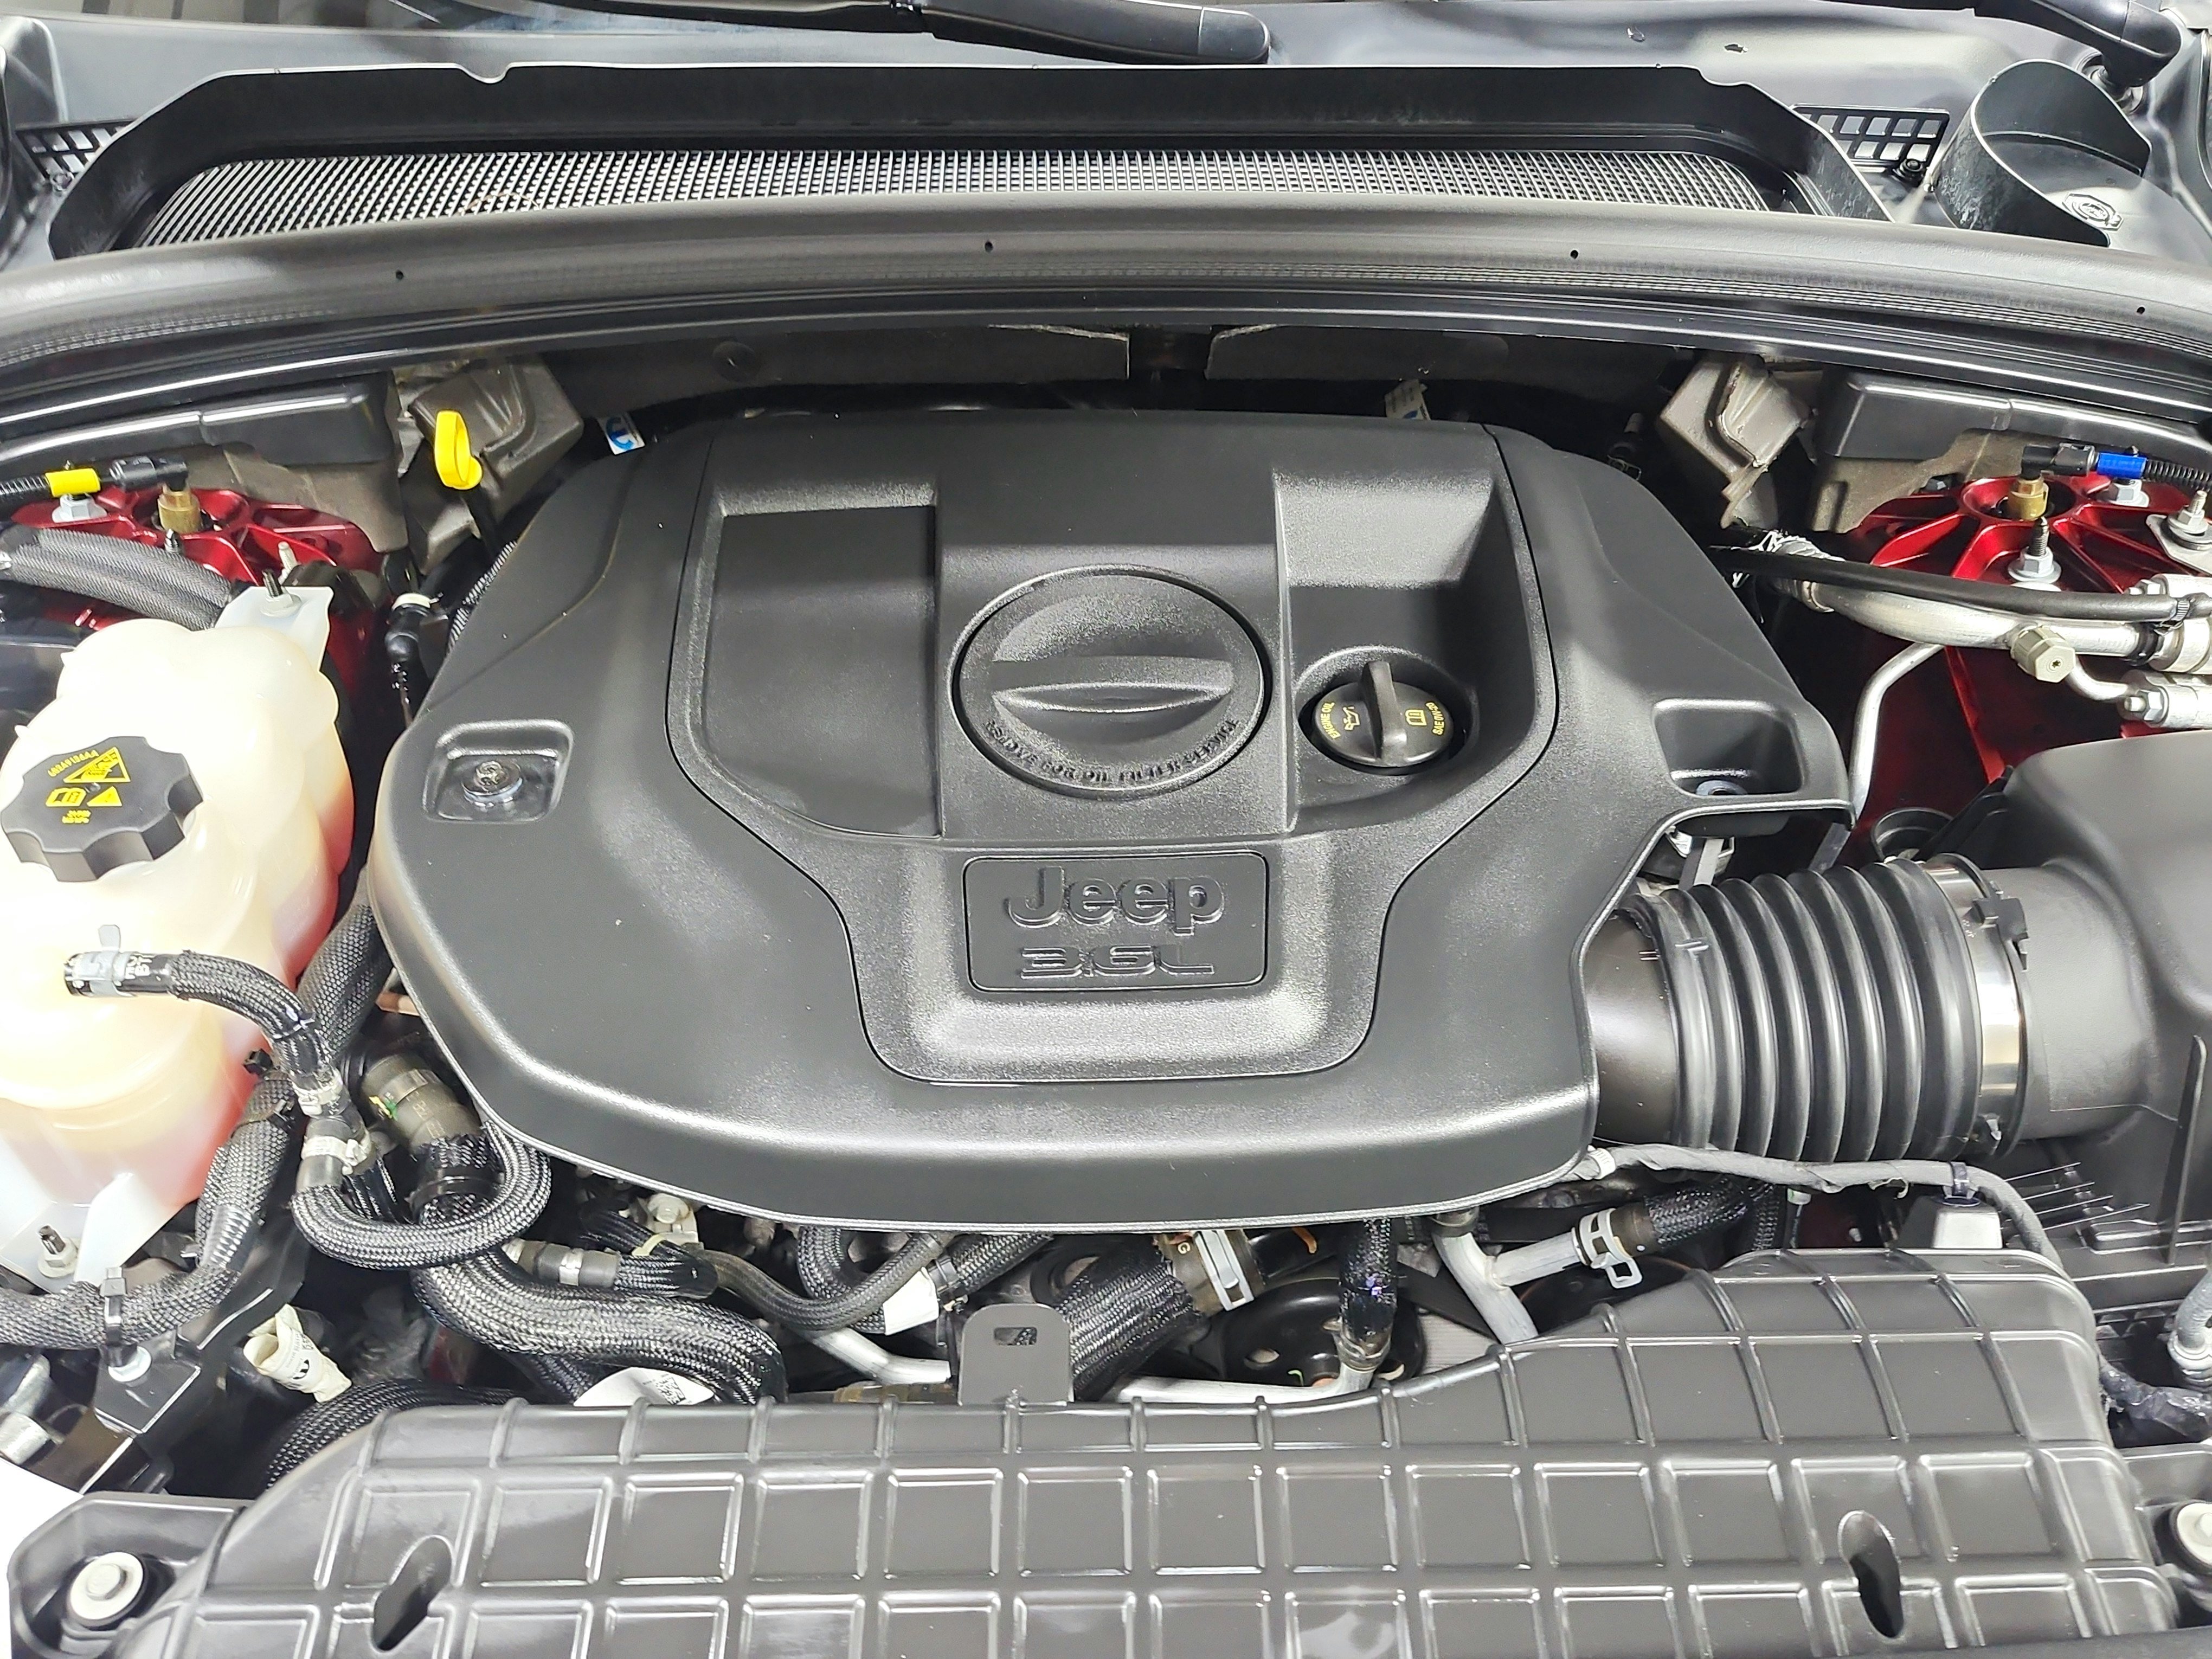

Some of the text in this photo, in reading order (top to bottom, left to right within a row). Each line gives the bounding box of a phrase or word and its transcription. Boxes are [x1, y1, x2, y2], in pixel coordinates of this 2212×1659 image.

[1320, 702, 1341, 740] ENGINE OIL
[1425, 702, 1445, 736] SAE 0W-20
[1183, 717, 1239, 764] SERVICE
[1004, 865, 1226, 936] Jeep
[1020, 944, 1215, 980] 3.6L
